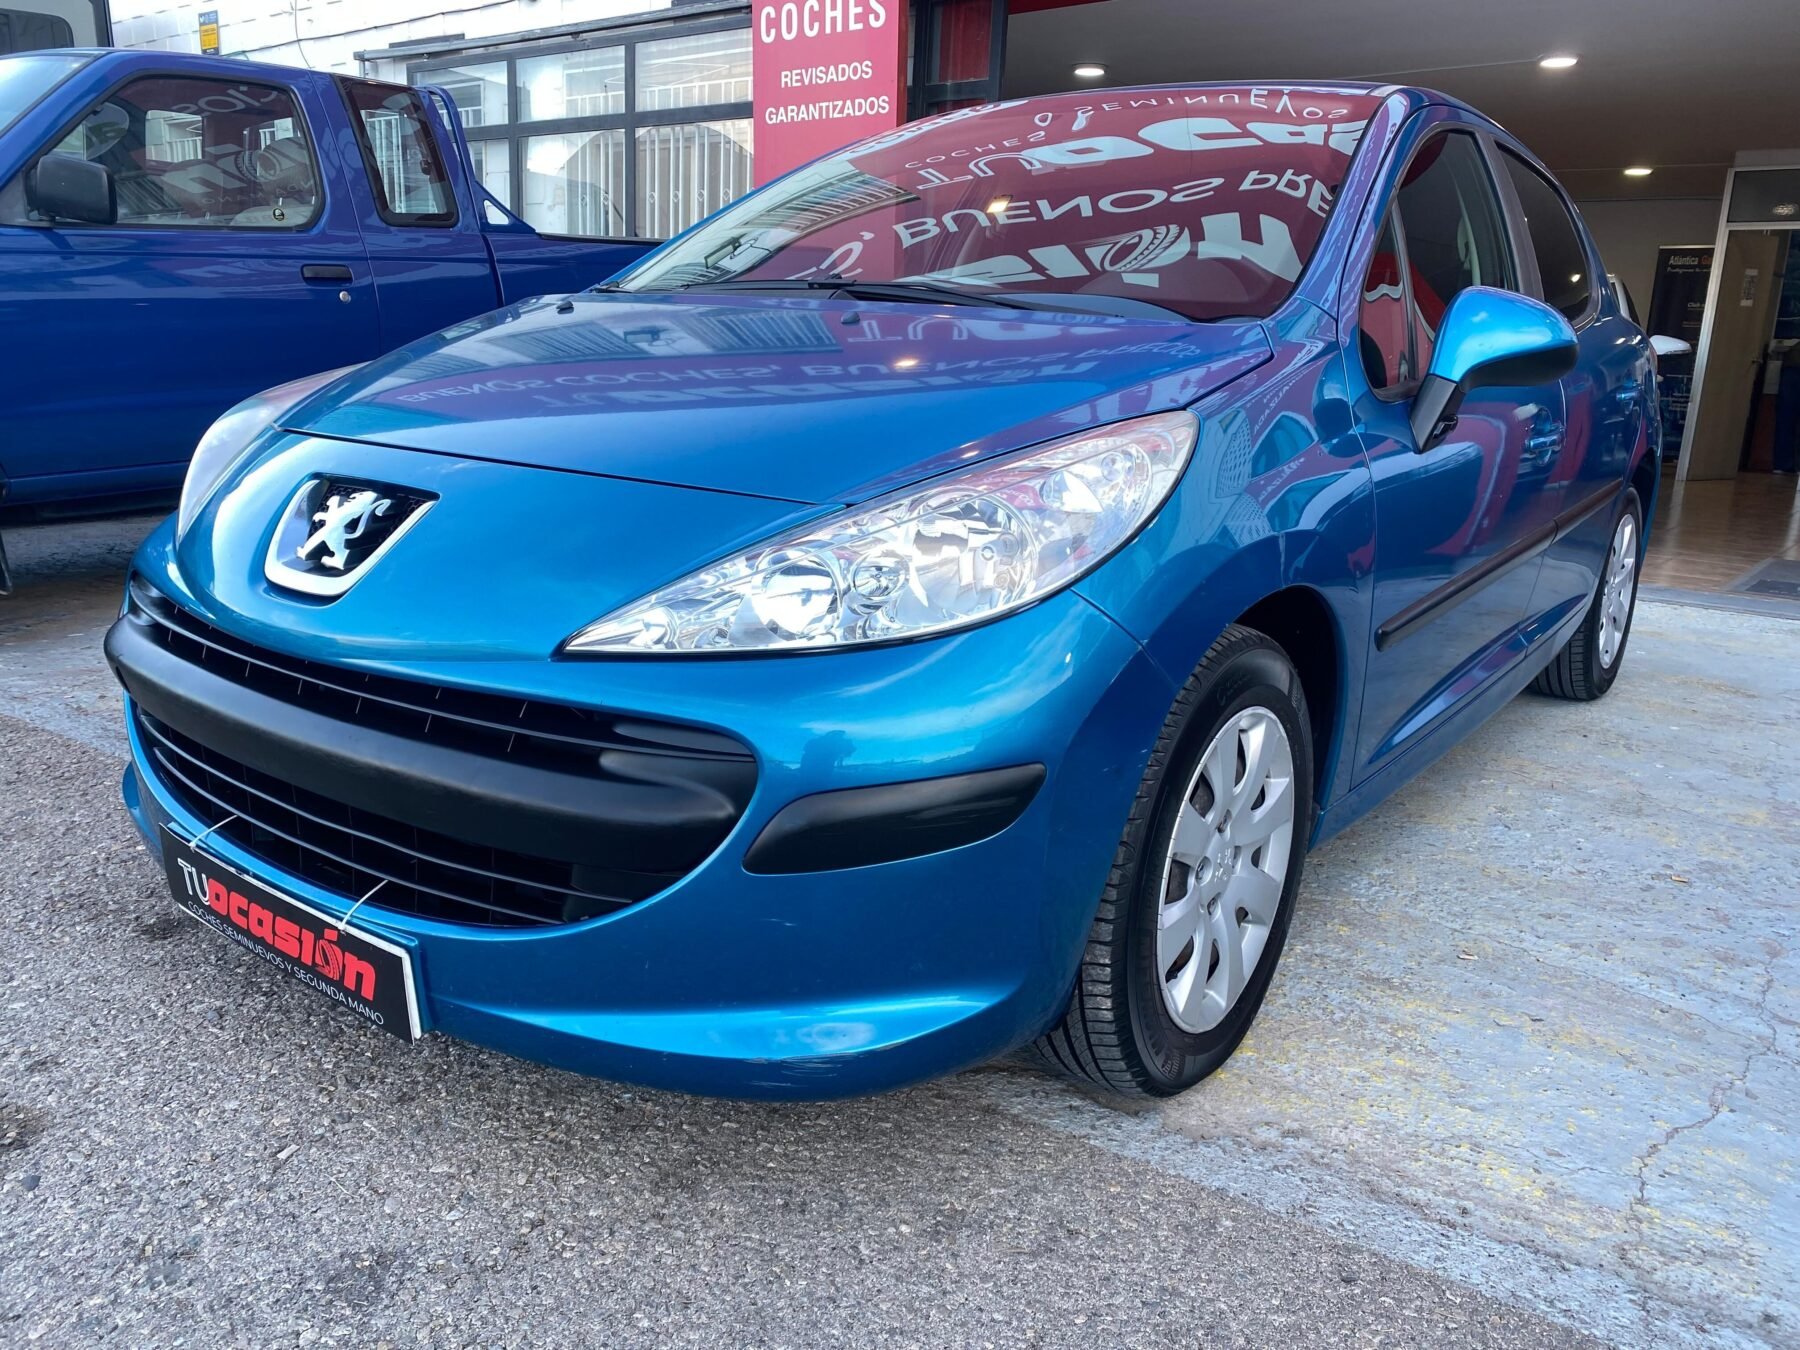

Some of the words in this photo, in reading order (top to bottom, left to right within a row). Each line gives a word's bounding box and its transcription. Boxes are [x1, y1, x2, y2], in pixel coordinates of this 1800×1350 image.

[760, 0, 886, 44] COCHES
[781, 60, 873, 89] REVISADOS
[765, 95, 890, 125] GARANTIZADOS
[188, 901, 224, 931] COCHES
[223, 923, 286, 969] SEMINUEVOS
[284, 961, 292, 973] Y
[294, 966, 347, 1006] SEGUNDA
[347, 996, 385, 1026] MANO
